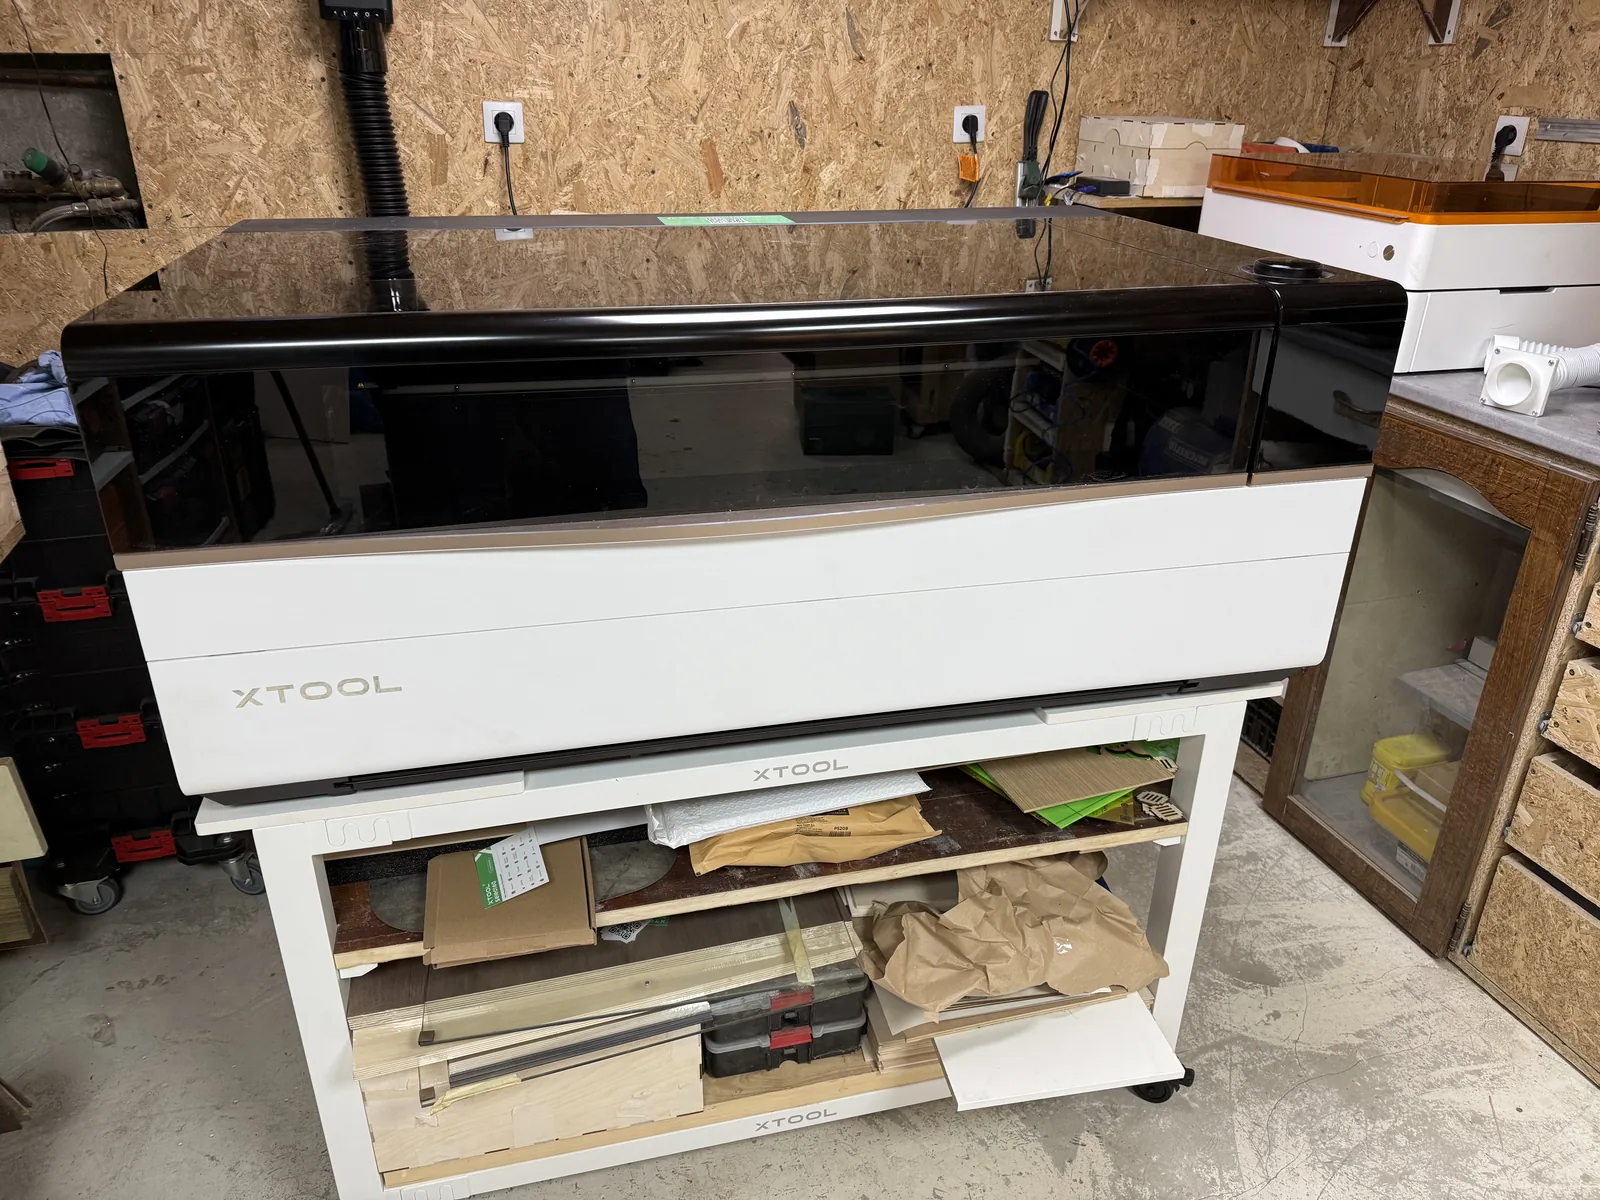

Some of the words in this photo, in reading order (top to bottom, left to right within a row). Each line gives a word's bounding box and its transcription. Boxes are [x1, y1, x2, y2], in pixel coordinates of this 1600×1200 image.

[231, 675, 403, 709] XTOOL
[753, 759, 849, 782] XTOOL
[755, 1108, 838, 1132] XTOOL
